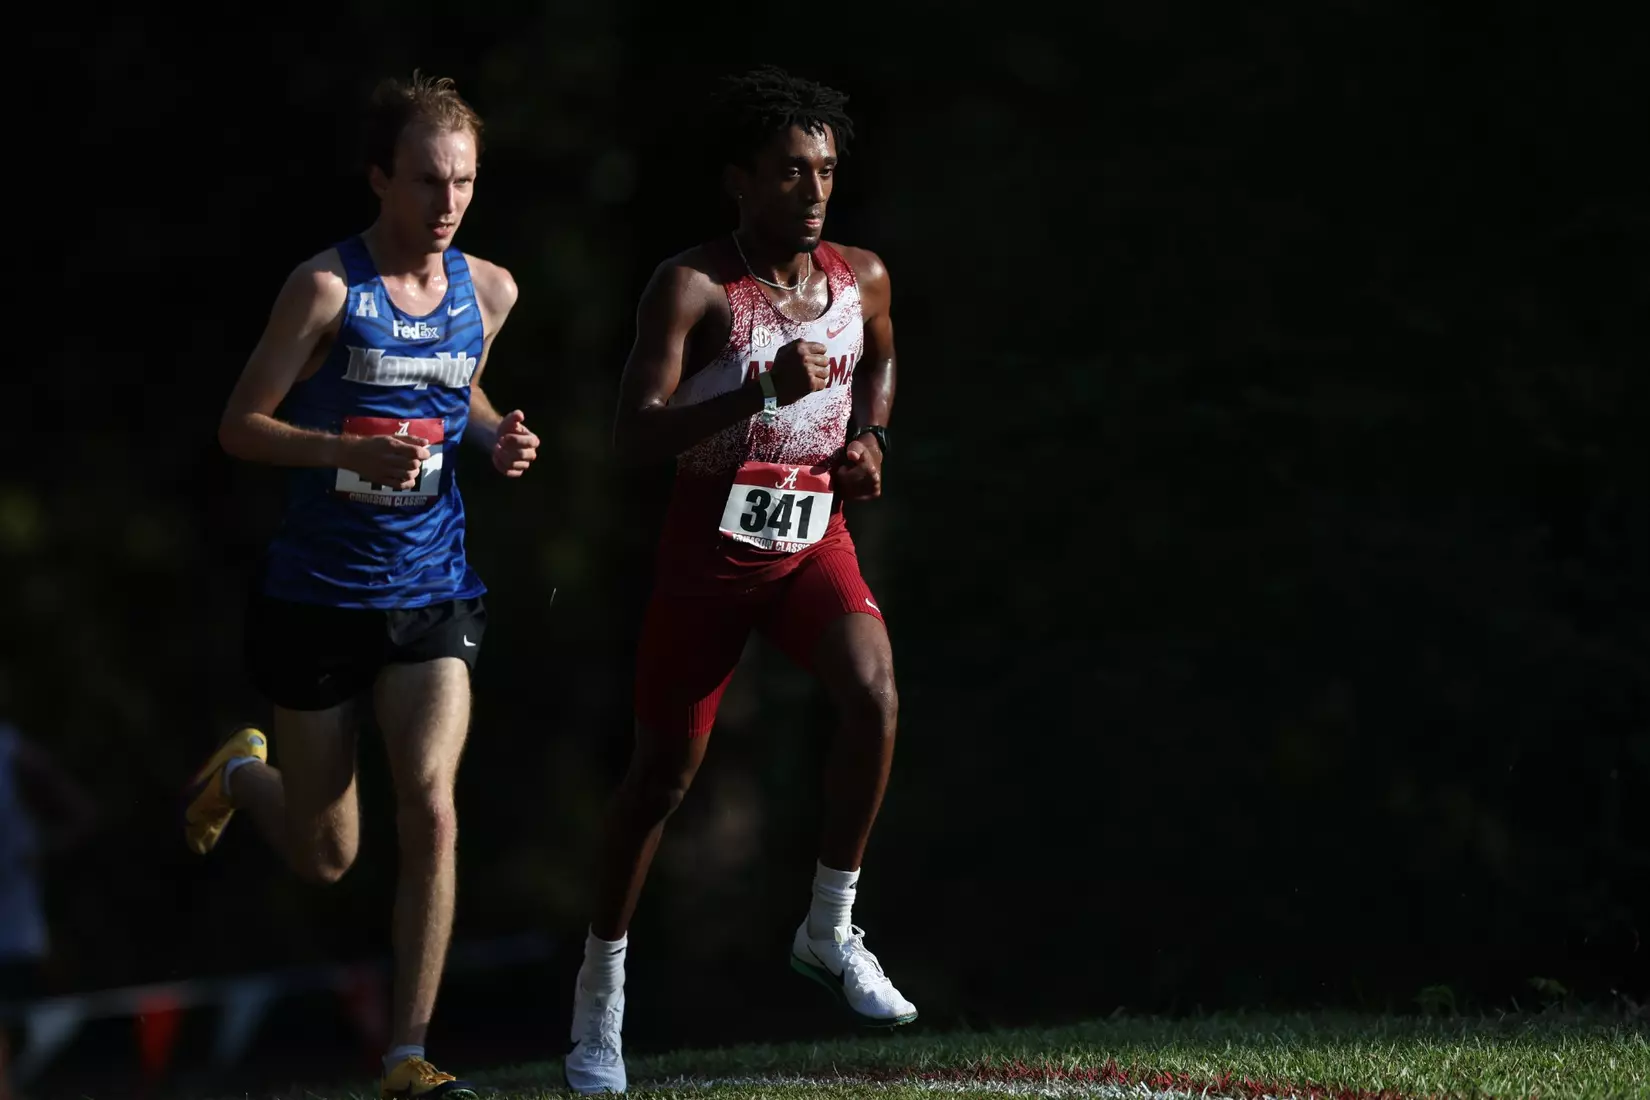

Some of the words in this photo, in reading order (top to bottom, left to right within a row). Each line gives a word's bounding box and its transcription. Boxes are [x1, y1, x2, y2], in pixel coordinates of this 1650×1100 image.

[356, 292, 378, 318] A
[394, 321, 439, 339] FedEx
[752, 325, 771, 347] SEC
[342, 346, 476, 390] Memphis
[349, 492, 392, 507] CRIMSON
[394, 496, 428, 507] CLASSIC
[740, 489, 814, 539] 341
